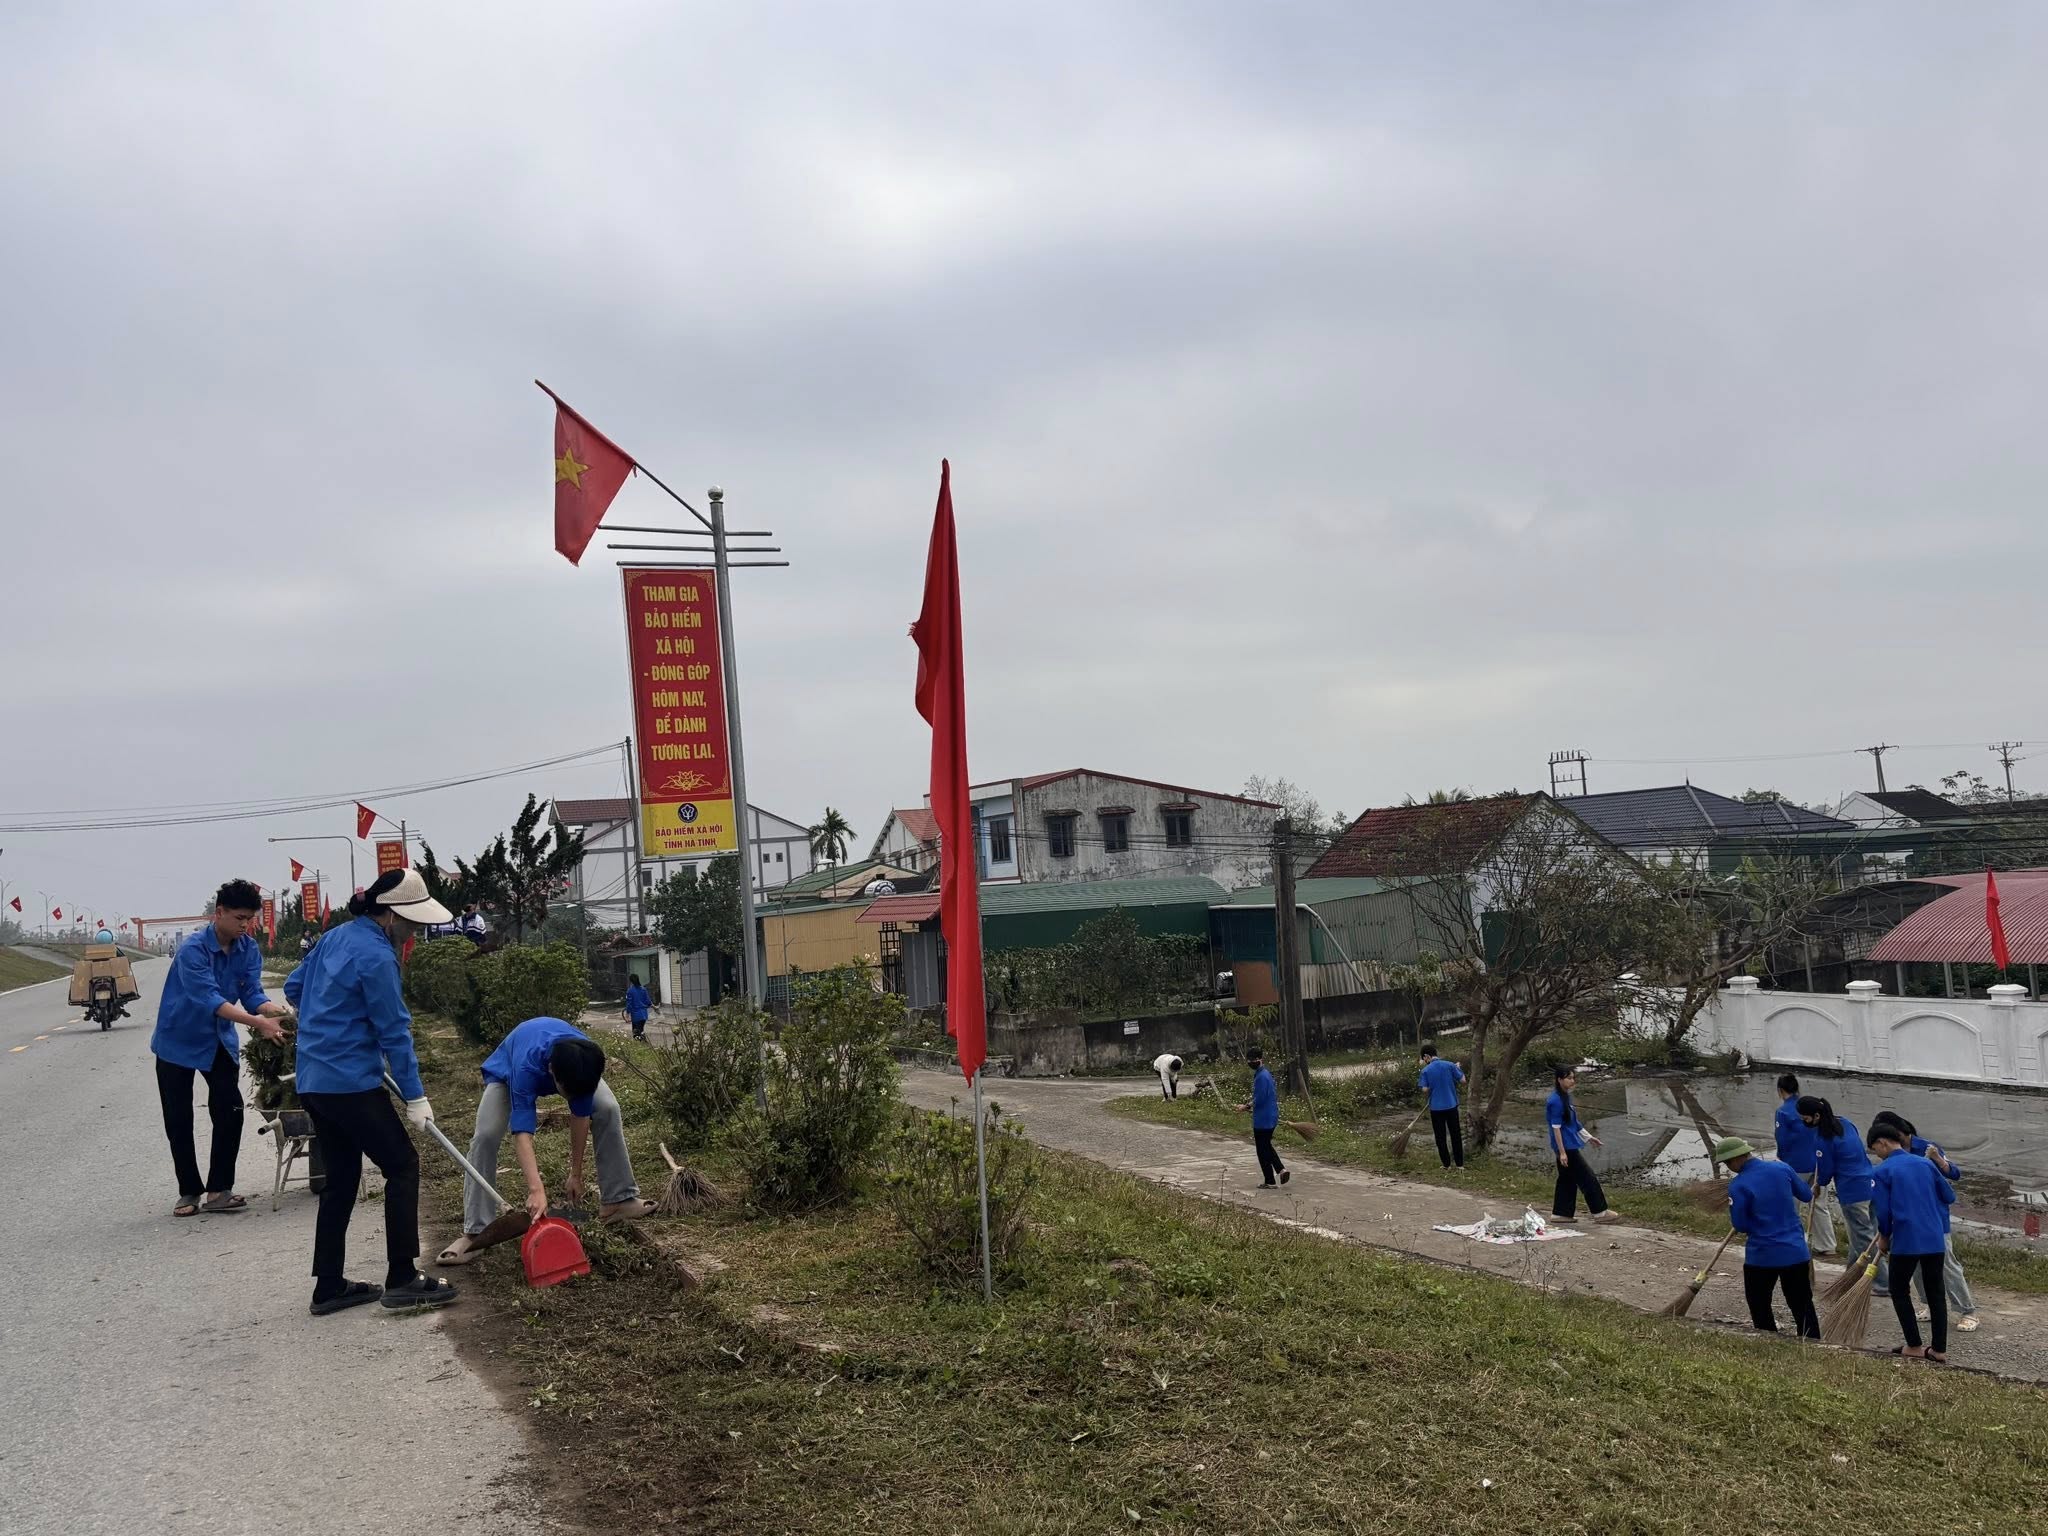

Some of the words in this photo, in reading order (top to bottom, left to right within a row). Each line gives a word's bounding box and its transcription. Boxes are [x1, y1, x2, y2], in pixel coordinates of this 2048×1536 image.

[642, 586, 676, 601] THAM
[679, 586, 699, 601] GIA
[644, 607, 669, 628] BẢO
[672, 606, 701, 628] HIỂM
[656, 636, 672, 654] XÃ
[675, 635, 695, 657] HỘI
[651, 662, 684, 680] ĐÓNG
[687, 661, 711, 680] GÓP
[652, 688, 679, 708] HÔM
[682, 690, 707, 708] NAY,
[655, 711, 672, 734] ĐỂ
[674, 714, 707, 733] DÀNH
[651, 743, 691, 761] TƯƠNG
[693, 743, 715, 759] LAI.
